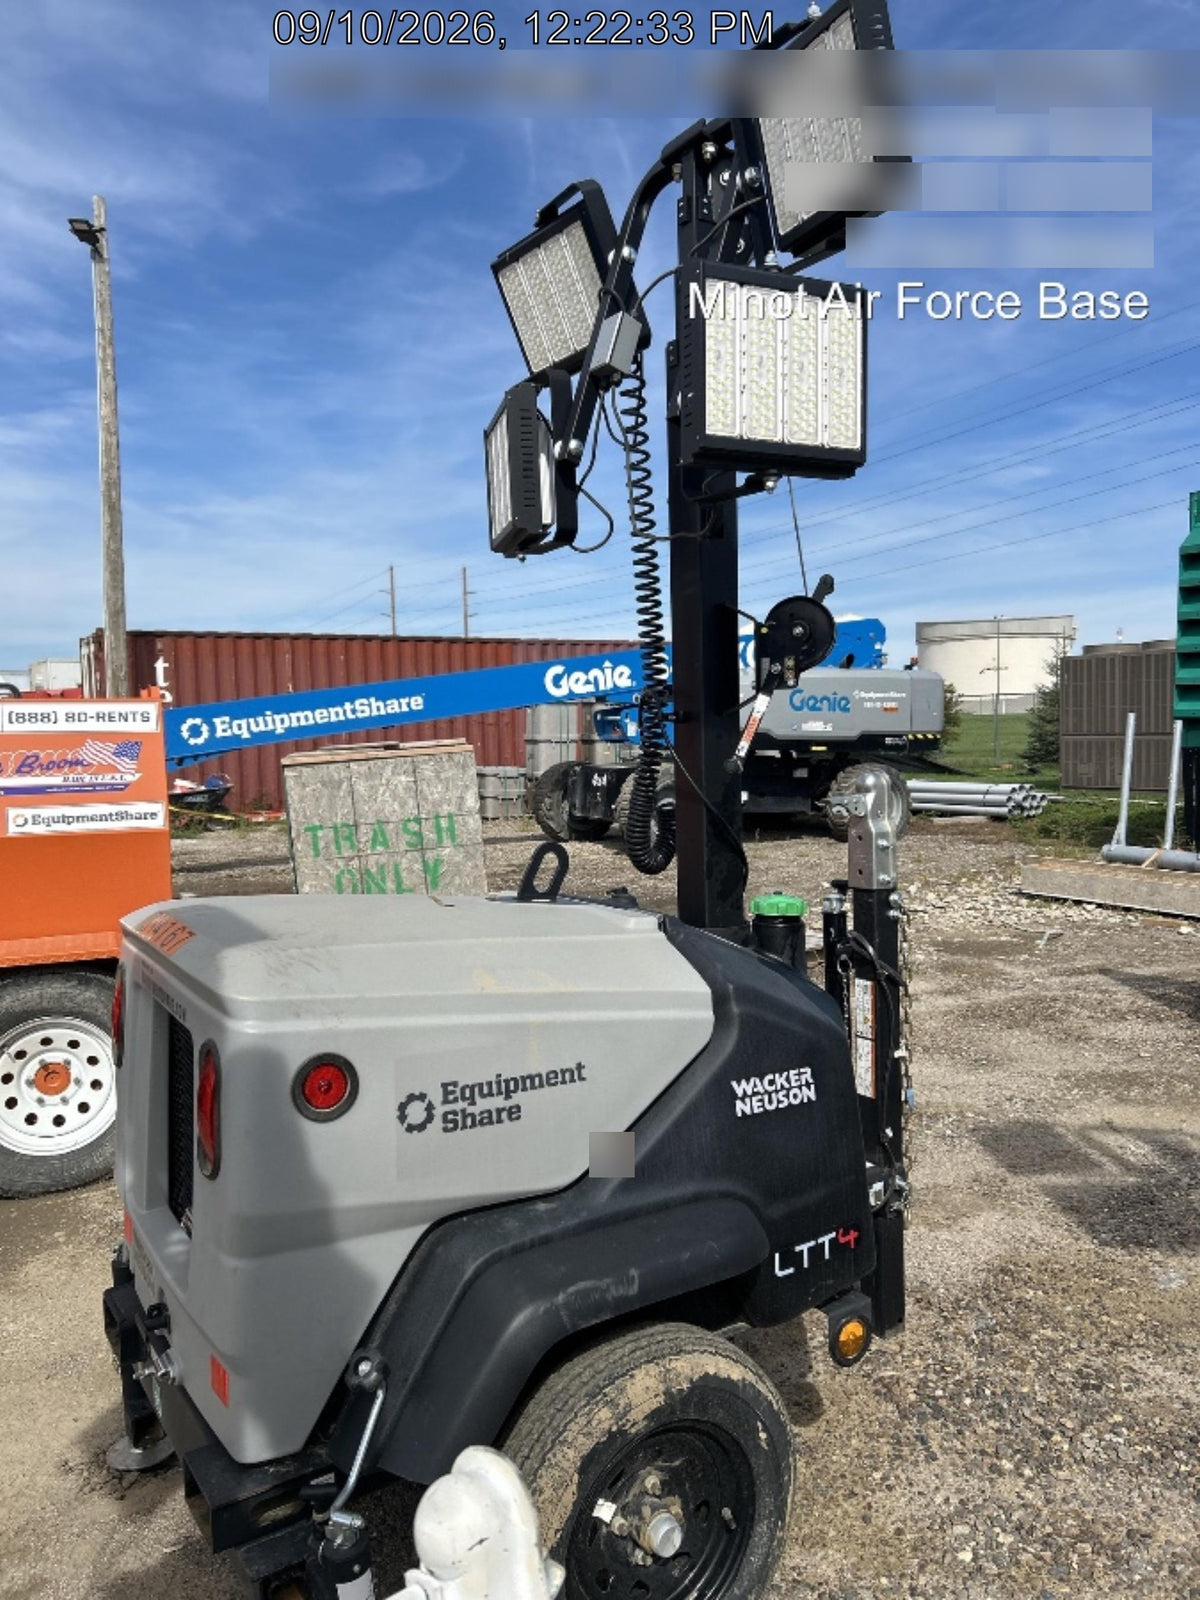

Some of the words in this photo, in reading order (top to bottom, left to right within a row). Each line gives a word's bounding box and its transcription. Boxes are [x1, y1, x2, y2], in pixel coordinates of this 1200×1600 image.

[544, 660, 632, 697] Genie
[8, 711, 58, 724] (888)
[64, 710, 150, 723] 80-RENTS
[213, 695, 424, 738] EquipmentShare
[789, 689, 851, 713] Genie
[31, 811, 158, 827] EquipmentShare
[302, 812, 456, 858] TRASH
[335, 853, 443, 895] ONLY
[440, 1061, 587, 1106] Equipment
[730, 1066, 815, 1098] WACKER
[735, 1083, 817, 1117] NEUSON
[441, 1103, 522, 1133] Share
[774, 1227, 859, 1277] LTT4
